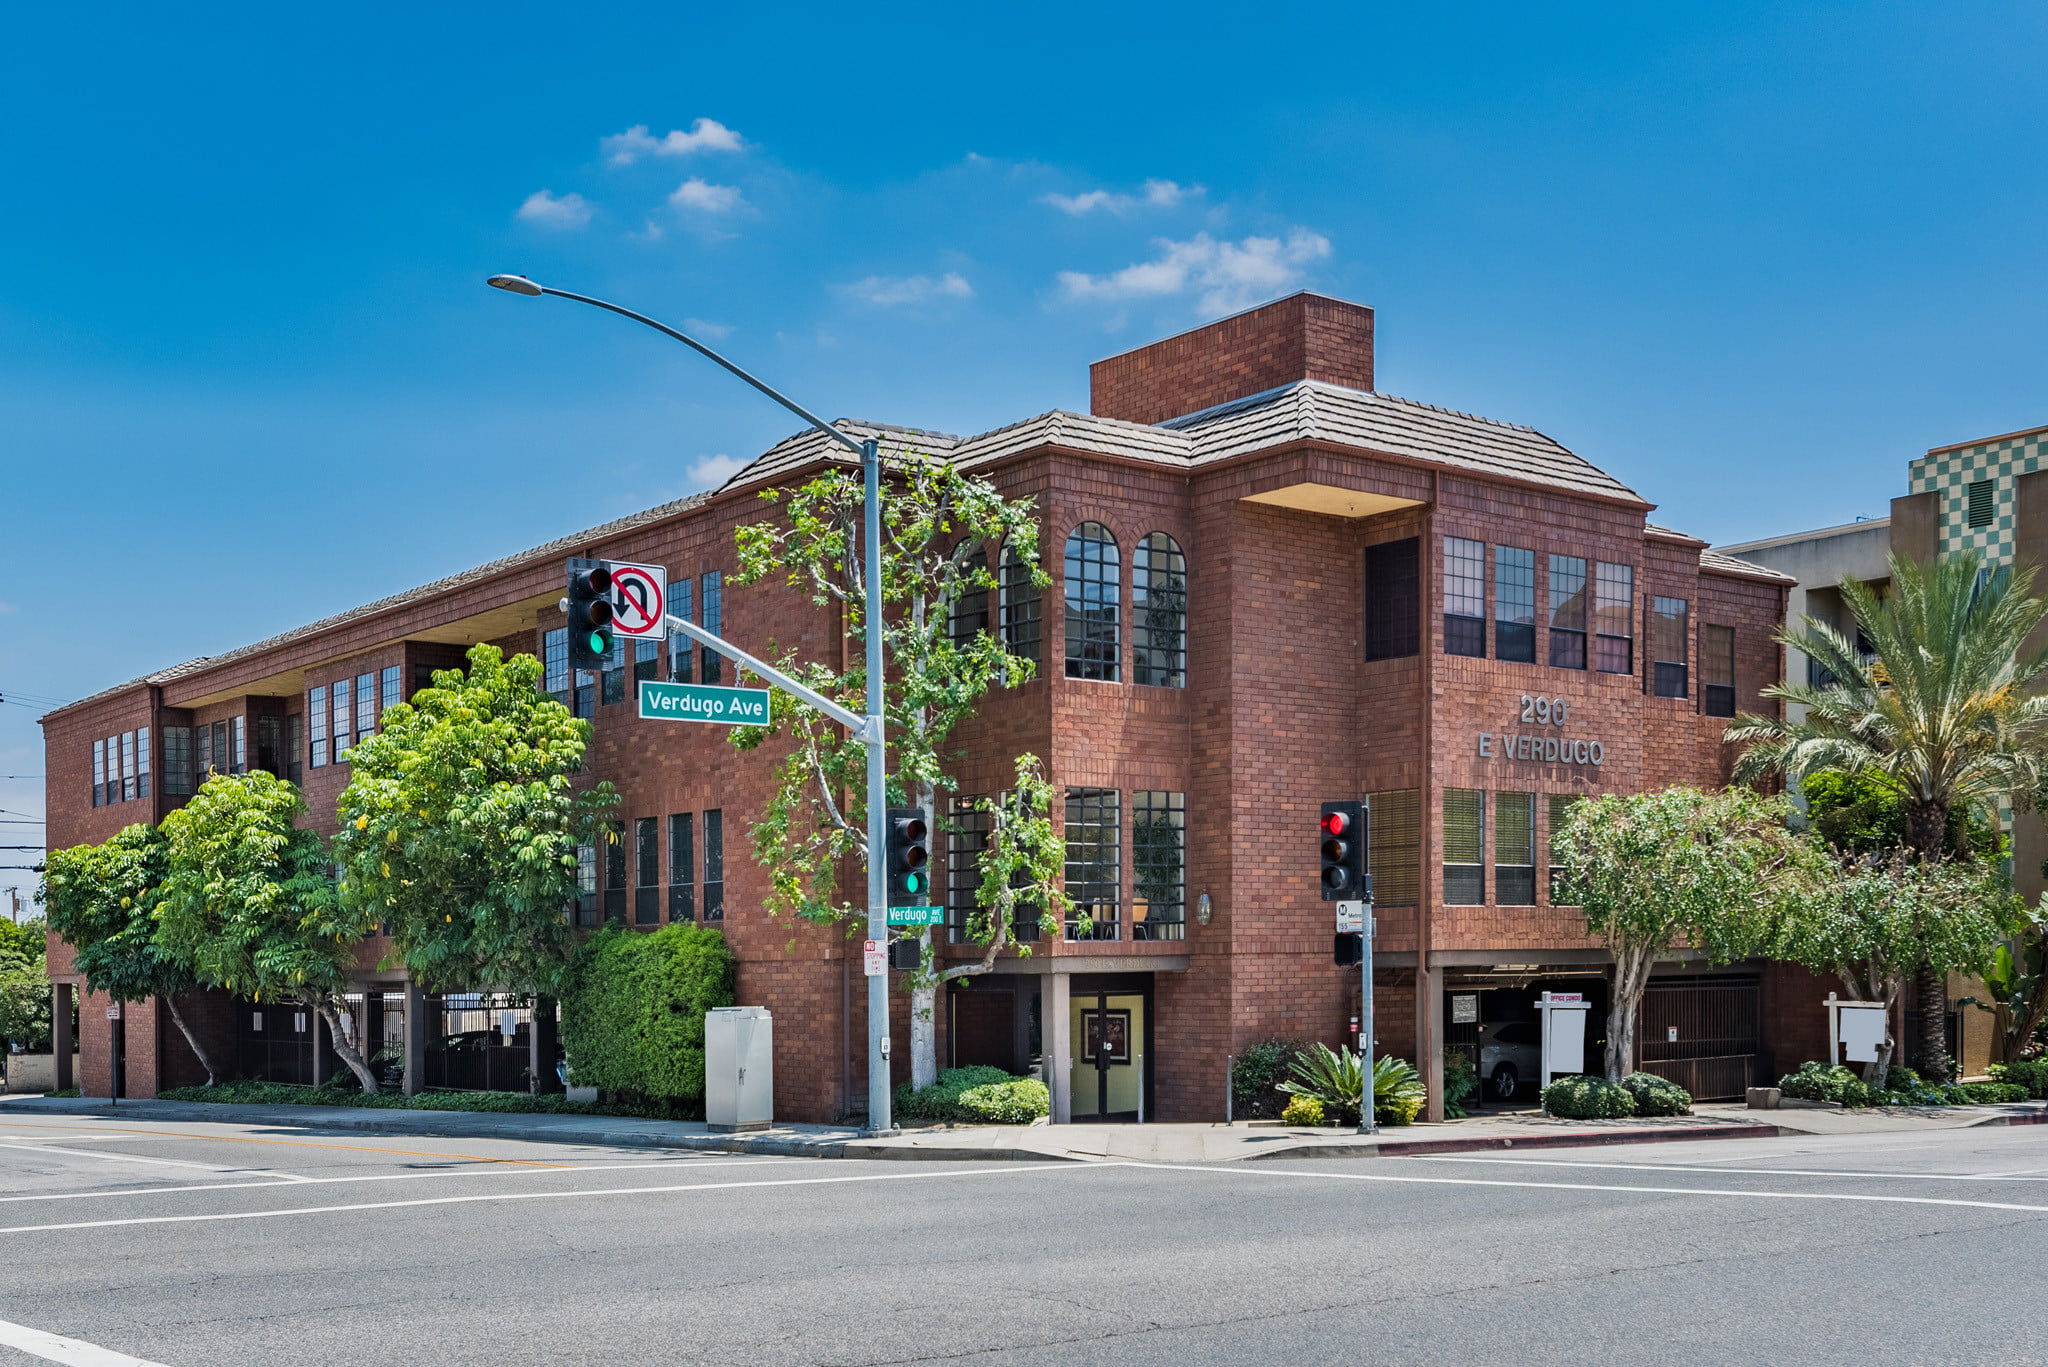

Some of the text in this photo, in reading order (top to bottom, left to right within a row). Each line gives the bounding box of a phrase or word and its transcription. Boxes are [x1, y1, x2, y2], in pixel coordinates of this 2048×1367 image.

[648, 691, 763, 718] Verdugo Ave
[1521, 695, 1567, 726] 290
[1480, 733, 1604, 765] E VERDUGO
[889, 907, 927, 924] Verdugo
[866, 942, 875, 950] NO
